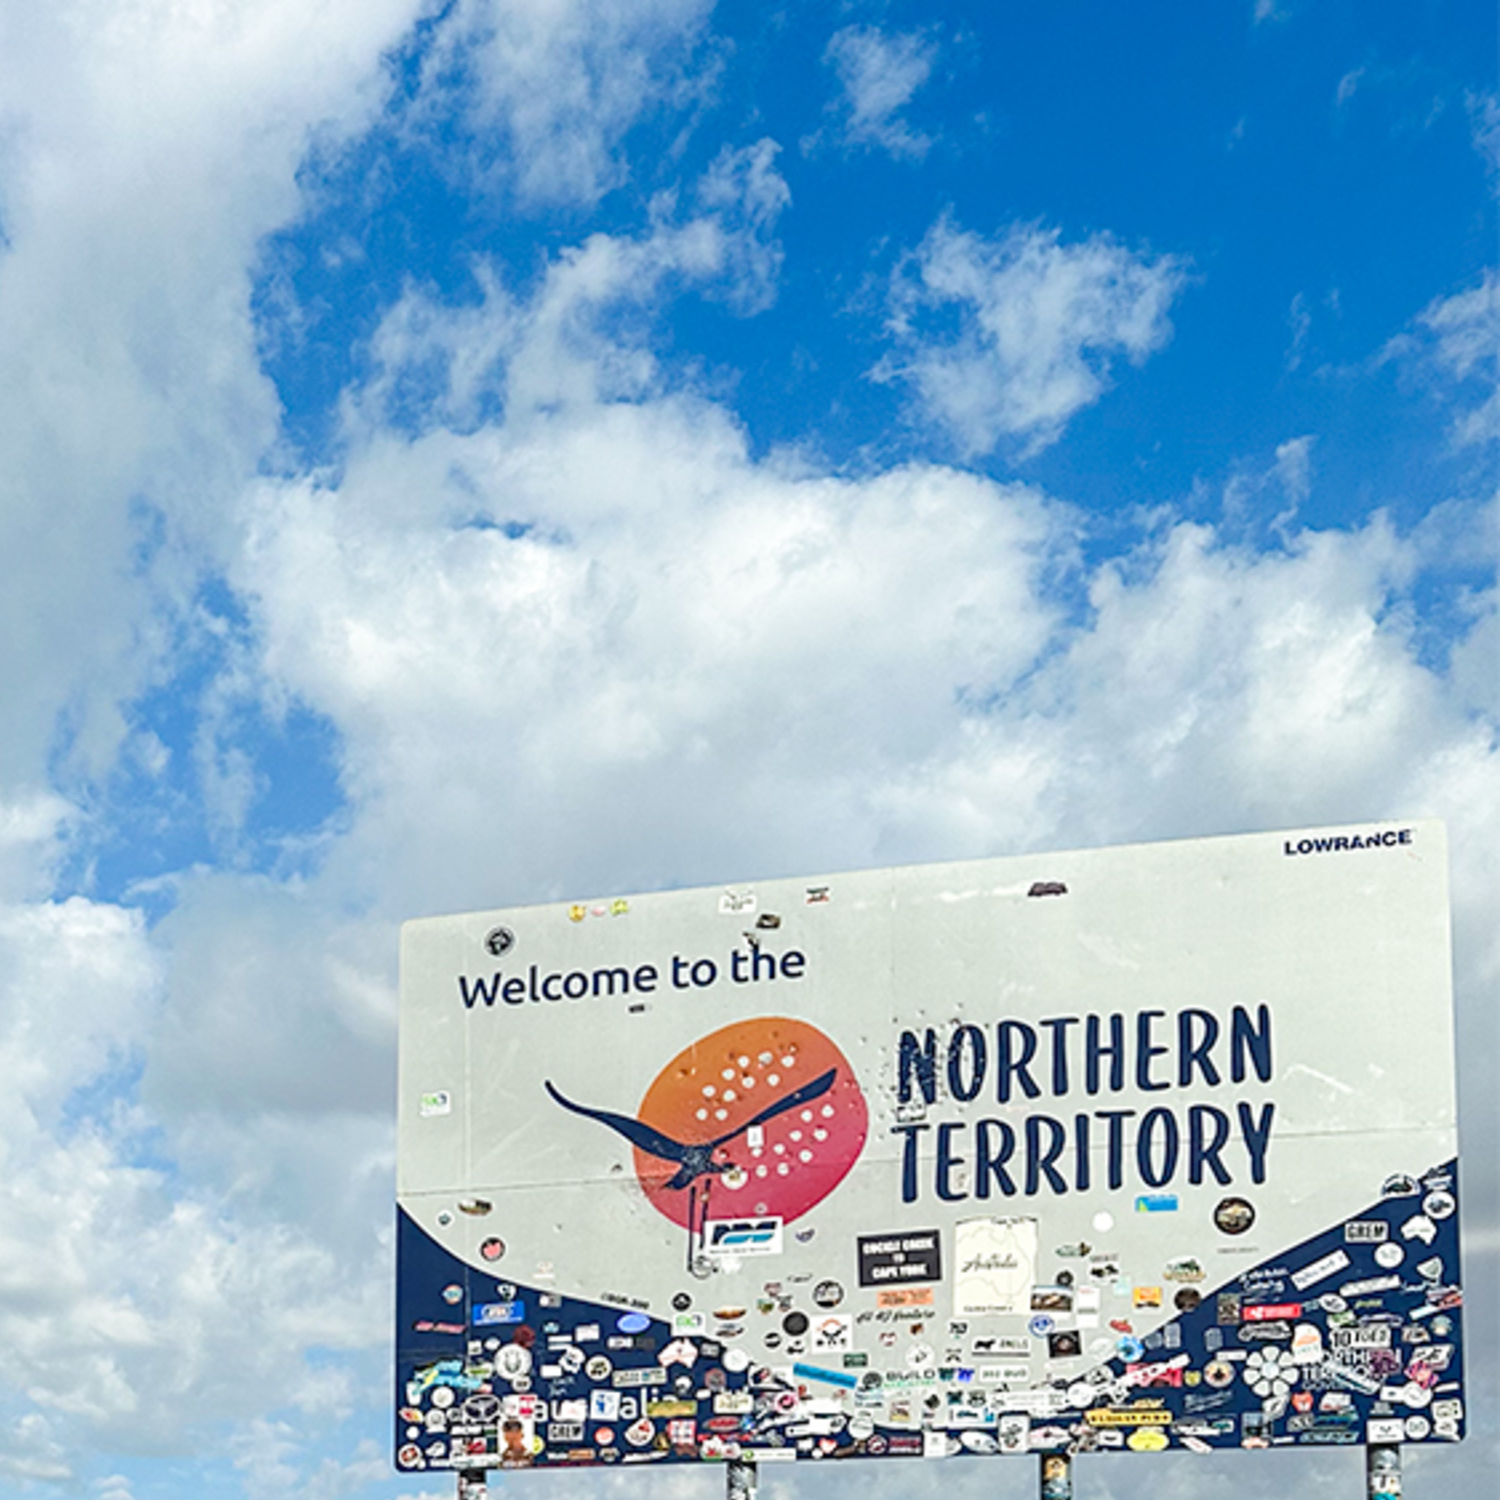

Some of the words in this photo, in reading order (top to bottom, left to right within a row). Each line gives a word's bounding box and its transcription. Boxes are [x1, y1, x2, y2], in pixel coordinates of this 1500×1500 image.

[1283, 829, 1412, 856] LOWRANCE
[458, 963, 660, 1009] Welcome
[671, 955, 717, 990] to
[731, 945, 807, 983] the
[897, 1004, 1273, 1104] NORTHERN
[890, 1102, 1275, 1203] TERRITORY
